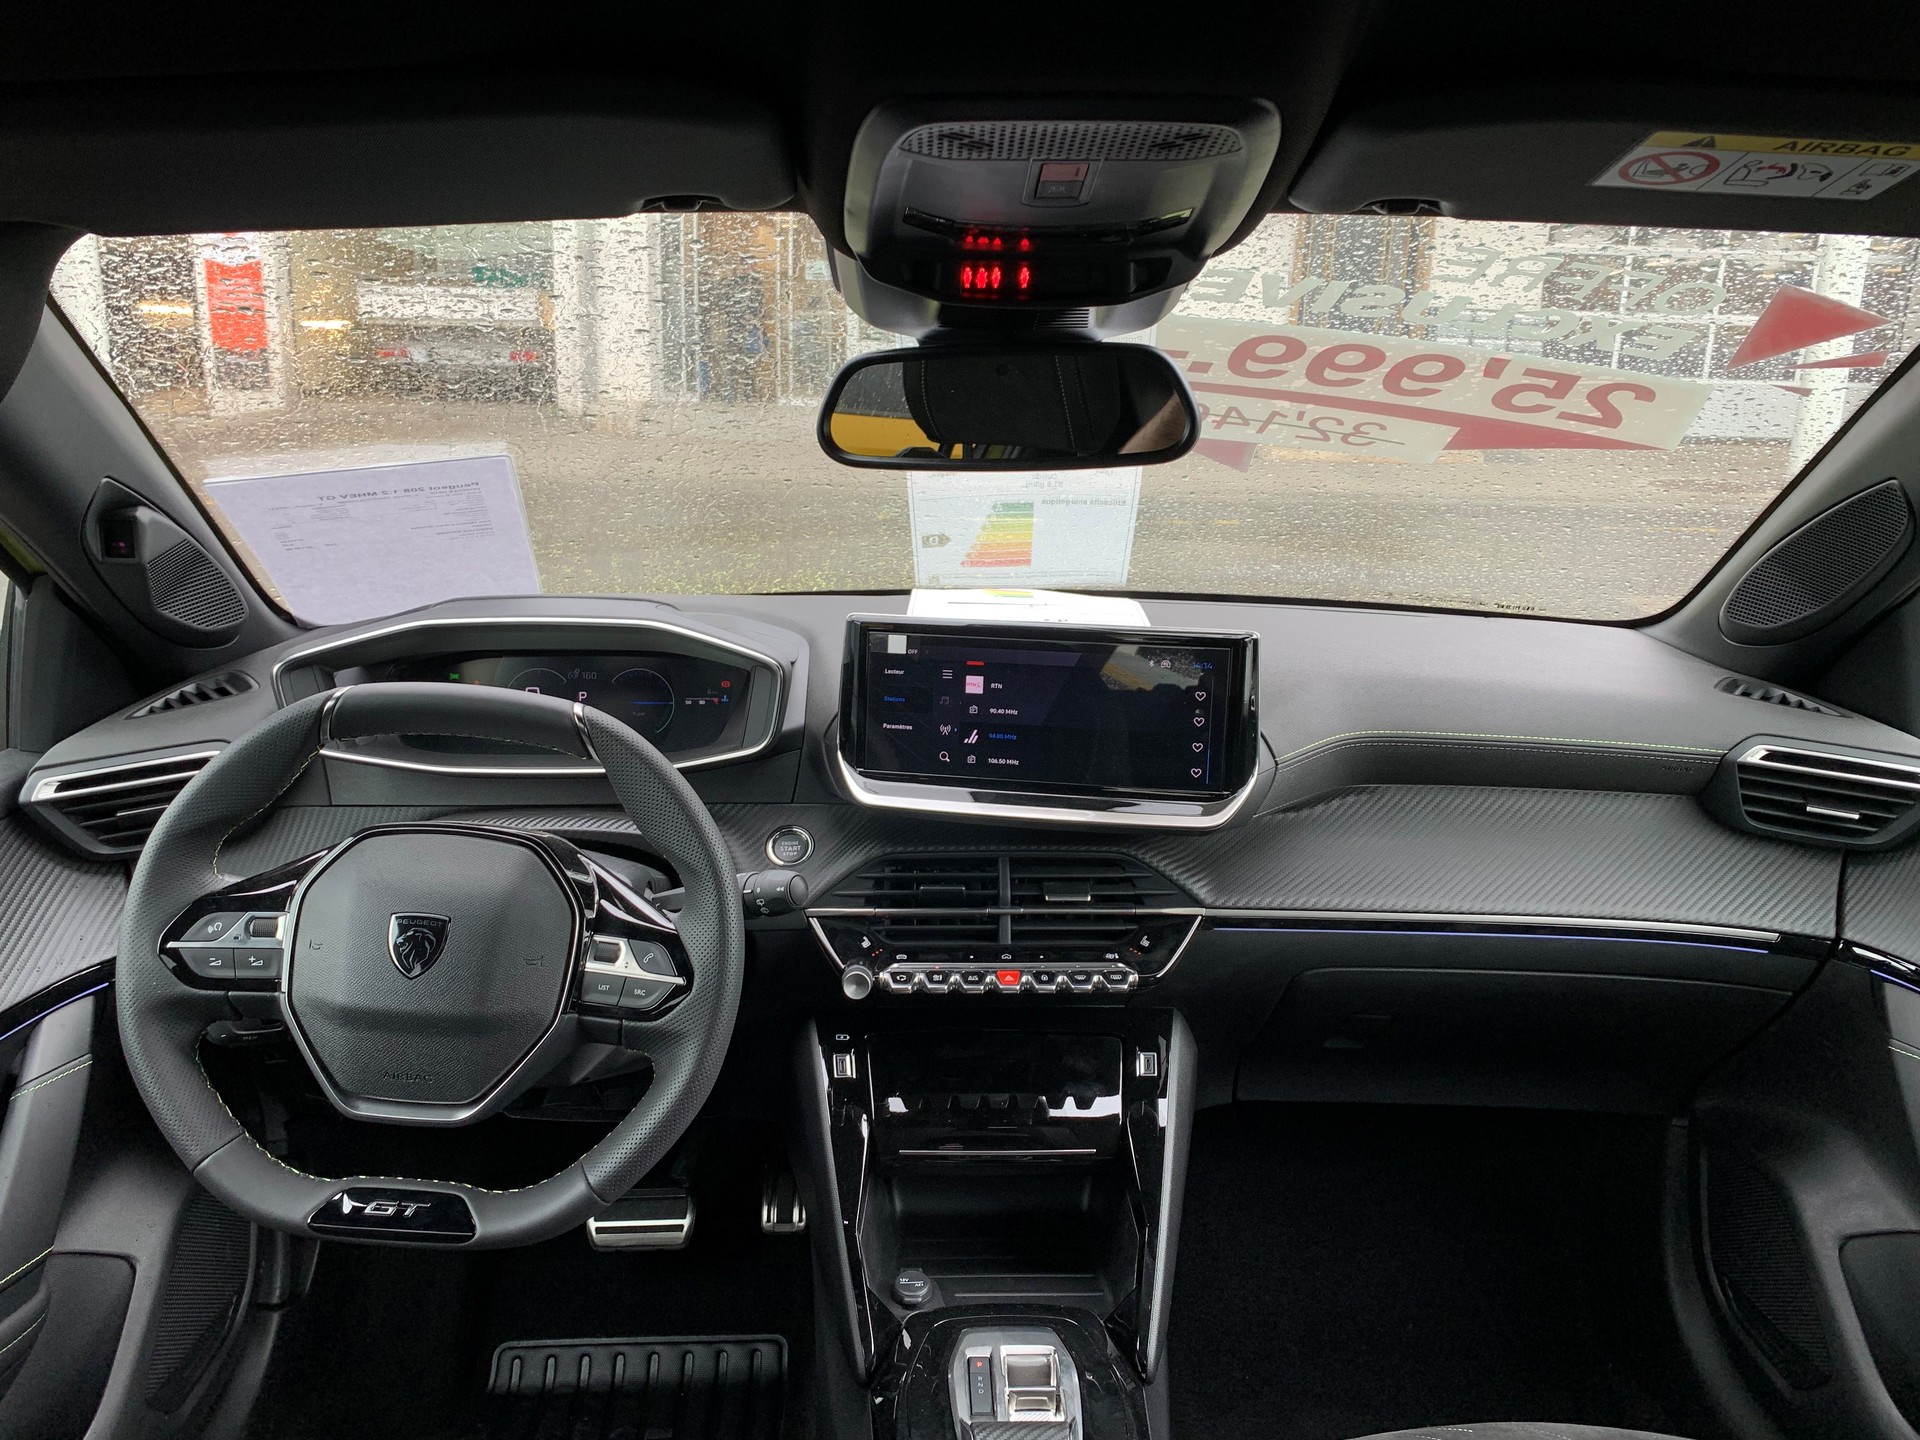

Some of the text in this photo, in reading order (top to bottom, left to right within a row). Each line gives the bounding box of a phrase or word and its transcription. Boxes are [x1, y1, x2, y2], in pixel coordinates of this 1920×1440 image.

[1772, 140, 1911, 157] AIRBAG
[581, 671, 597, 680] 160
[578, 691, 587, 701] P
[882, 722, 913, 731] Paramètres
[1006, 758, 1019, 766] MHz
[396, 918, 444, 927] PEUGEOT
[634, 988, 646, 996] SRC
[363, 1200, 432, 1218] GT
